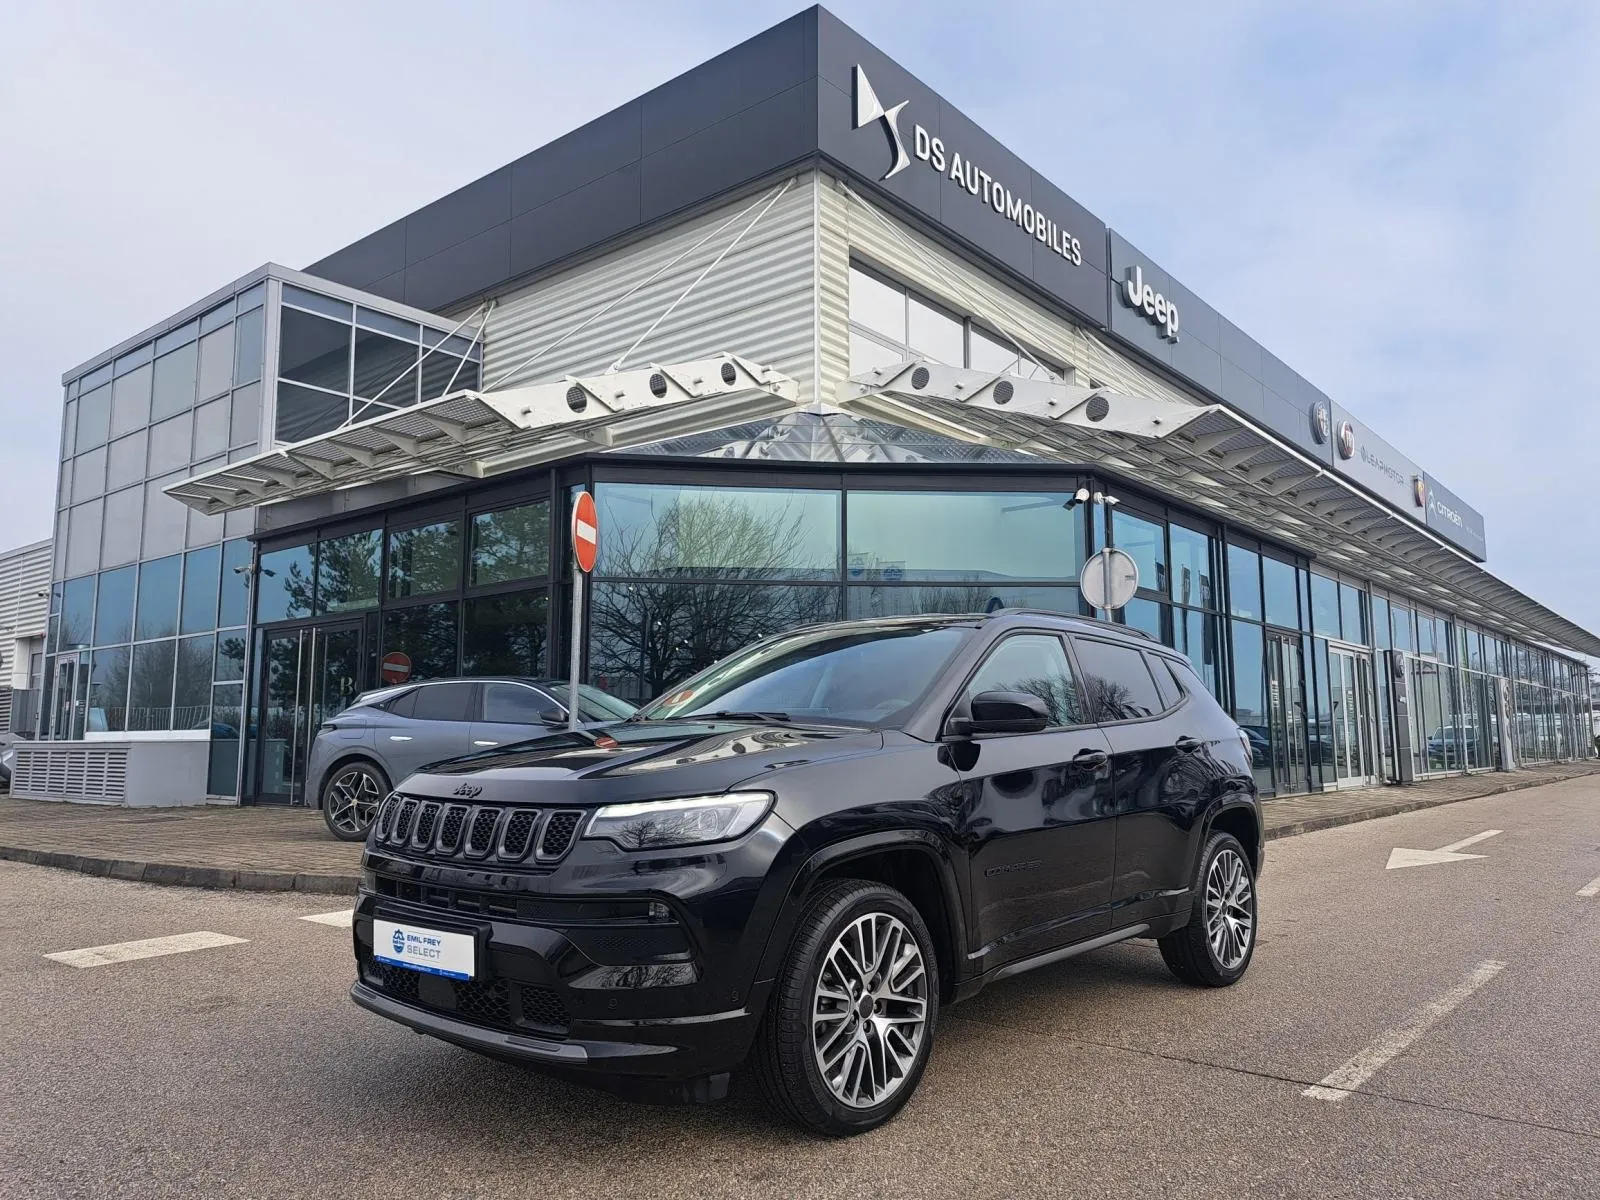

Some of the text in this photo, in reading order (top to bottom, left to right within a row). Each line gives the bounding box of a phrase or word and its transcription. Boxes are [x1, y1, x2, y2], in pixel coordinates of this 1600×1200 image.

[914, 123, 1082, 266] DS AUTOMOBILES
[1126, 265, 1179, 337] Jeep
[406, 945, 441, 959] SELECT
[407, 934, 422, 943] EMIL
[423, 936, 441, 946] FREY
